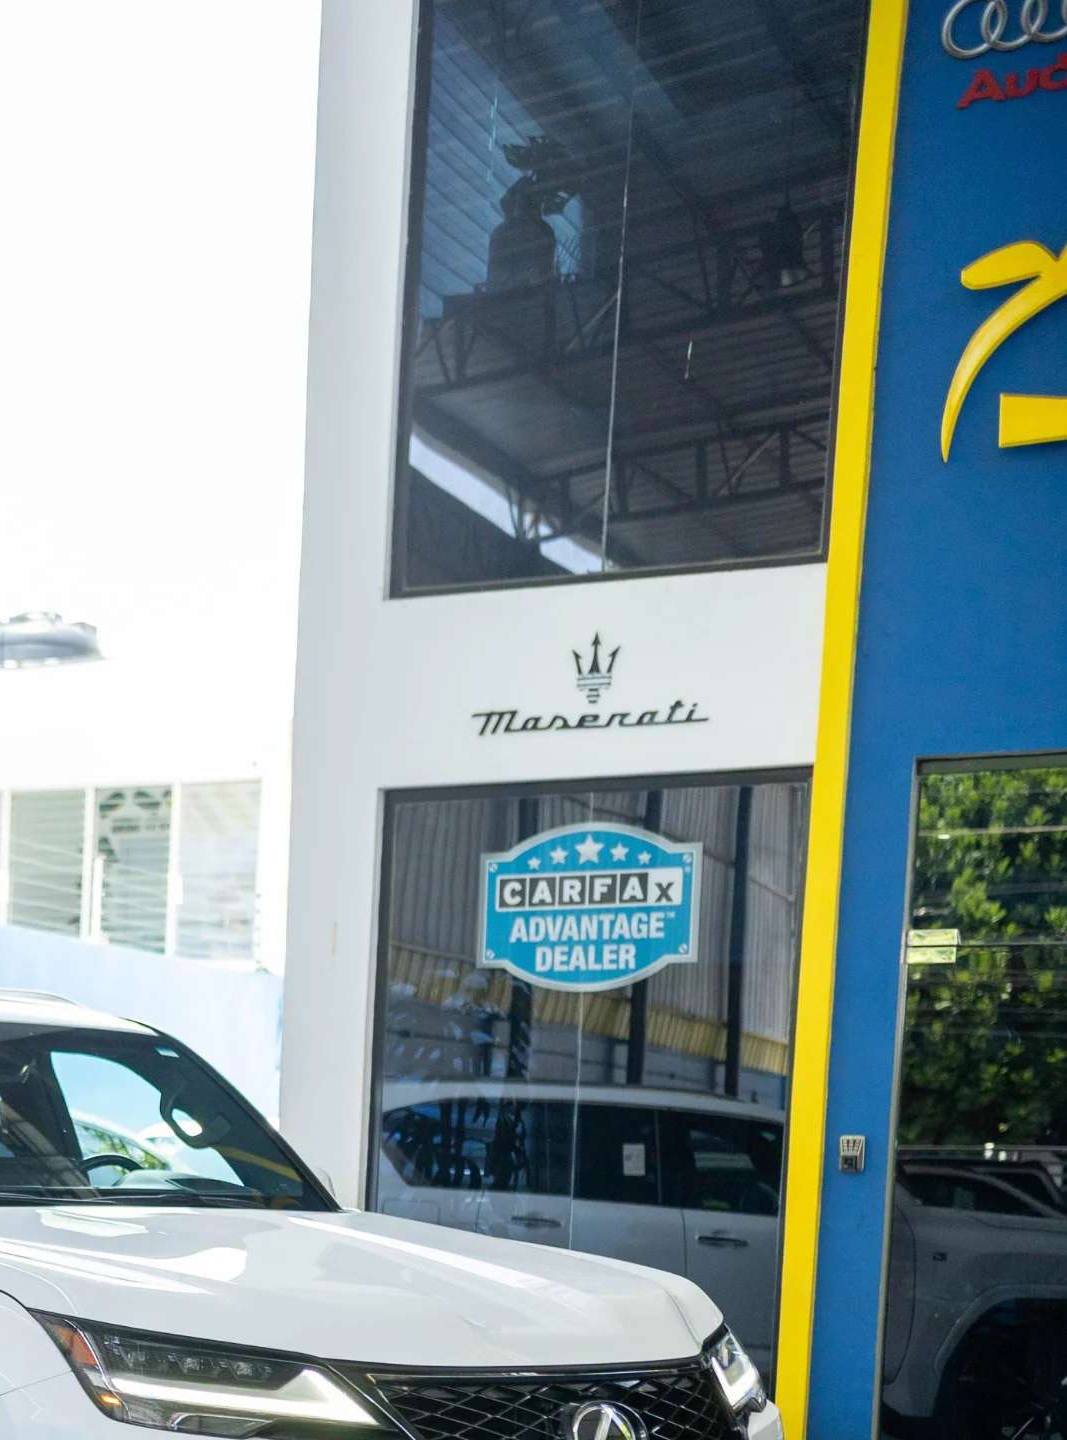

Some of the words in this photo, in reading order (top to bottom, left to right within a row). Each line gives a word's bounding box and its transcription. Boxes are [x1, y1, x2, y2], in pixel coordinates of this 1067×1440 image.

[471, 699, 709, 736] Maserati
[501, 874, 676, 905] CARFAX
[535, 943, 636, 972] DEALER
